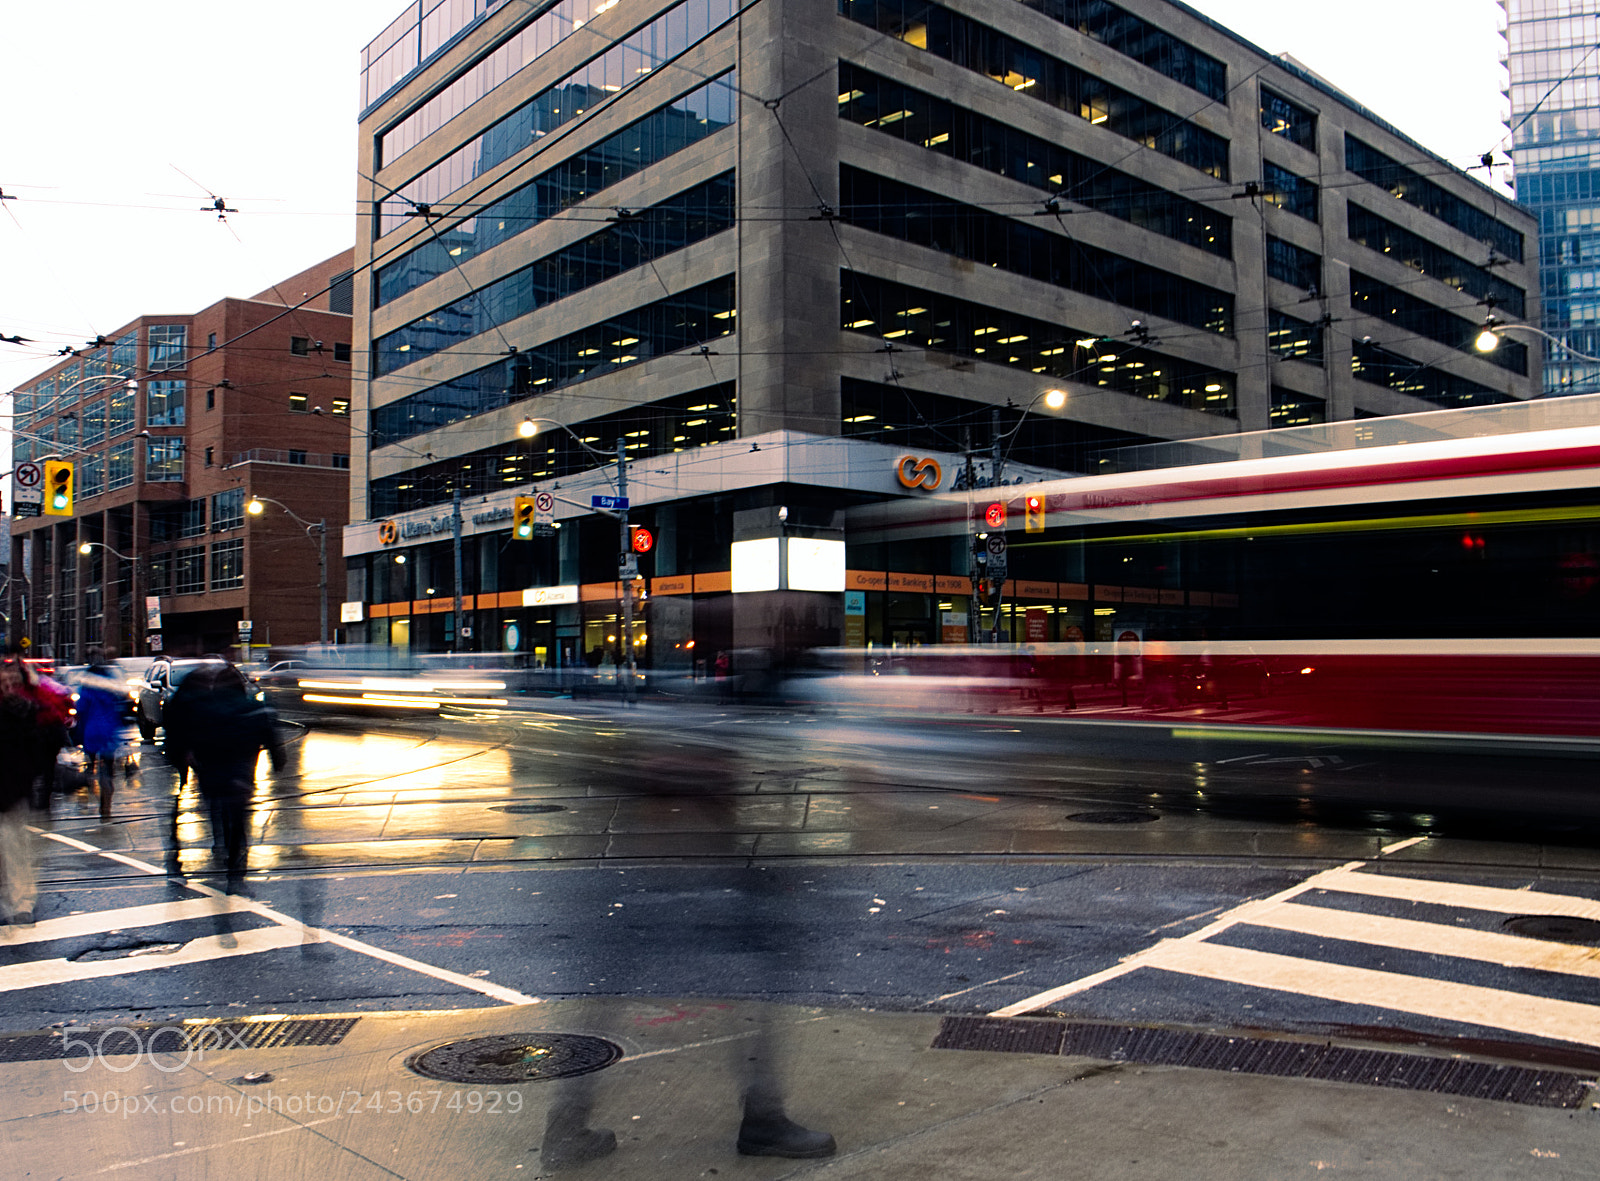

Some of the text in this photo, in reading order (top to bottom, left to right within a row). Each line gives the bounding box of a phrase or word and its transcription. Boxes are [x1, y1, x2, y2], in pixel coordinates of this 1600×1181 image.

[601, 496, 615, 509] Bay
[903, 577, 927, 590] Banking
[929, 579, 946, 589] Snce
[946, 579, 962, 589] 1908
